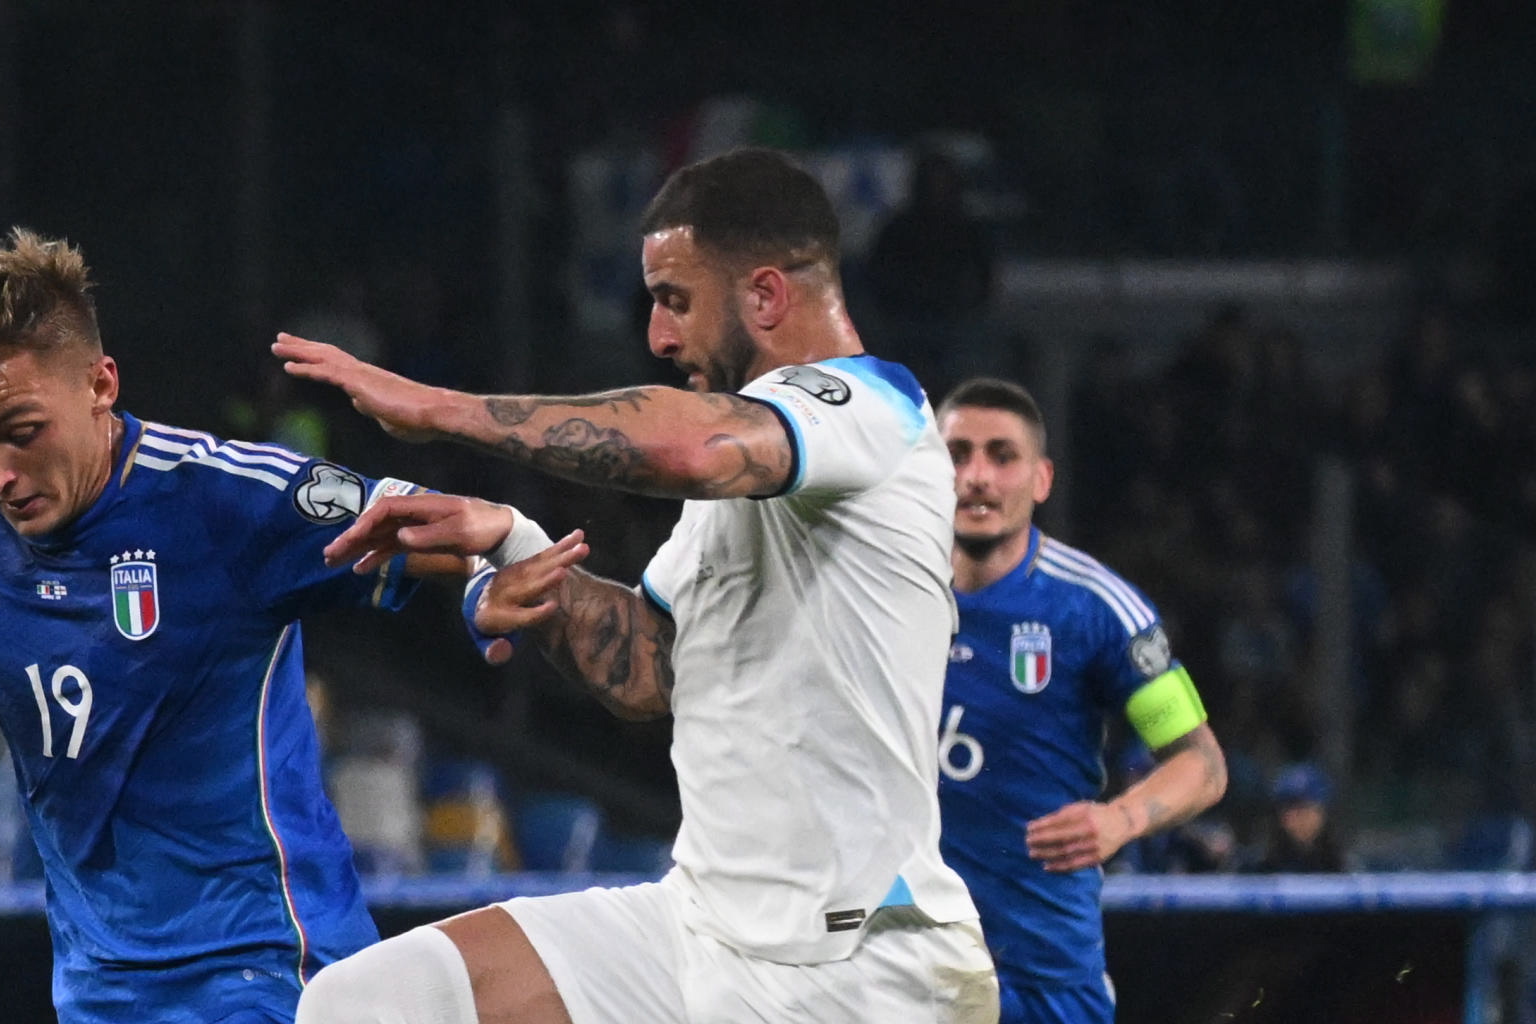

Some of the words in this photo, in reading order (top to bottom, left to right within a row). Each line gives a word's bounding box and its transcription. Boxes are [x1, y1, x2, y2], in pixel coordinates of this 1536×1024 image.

[114, 568, 152, 585] ITALIA
[24, 663, 93, 759] 19
[938, 705, 984, 782] 6
